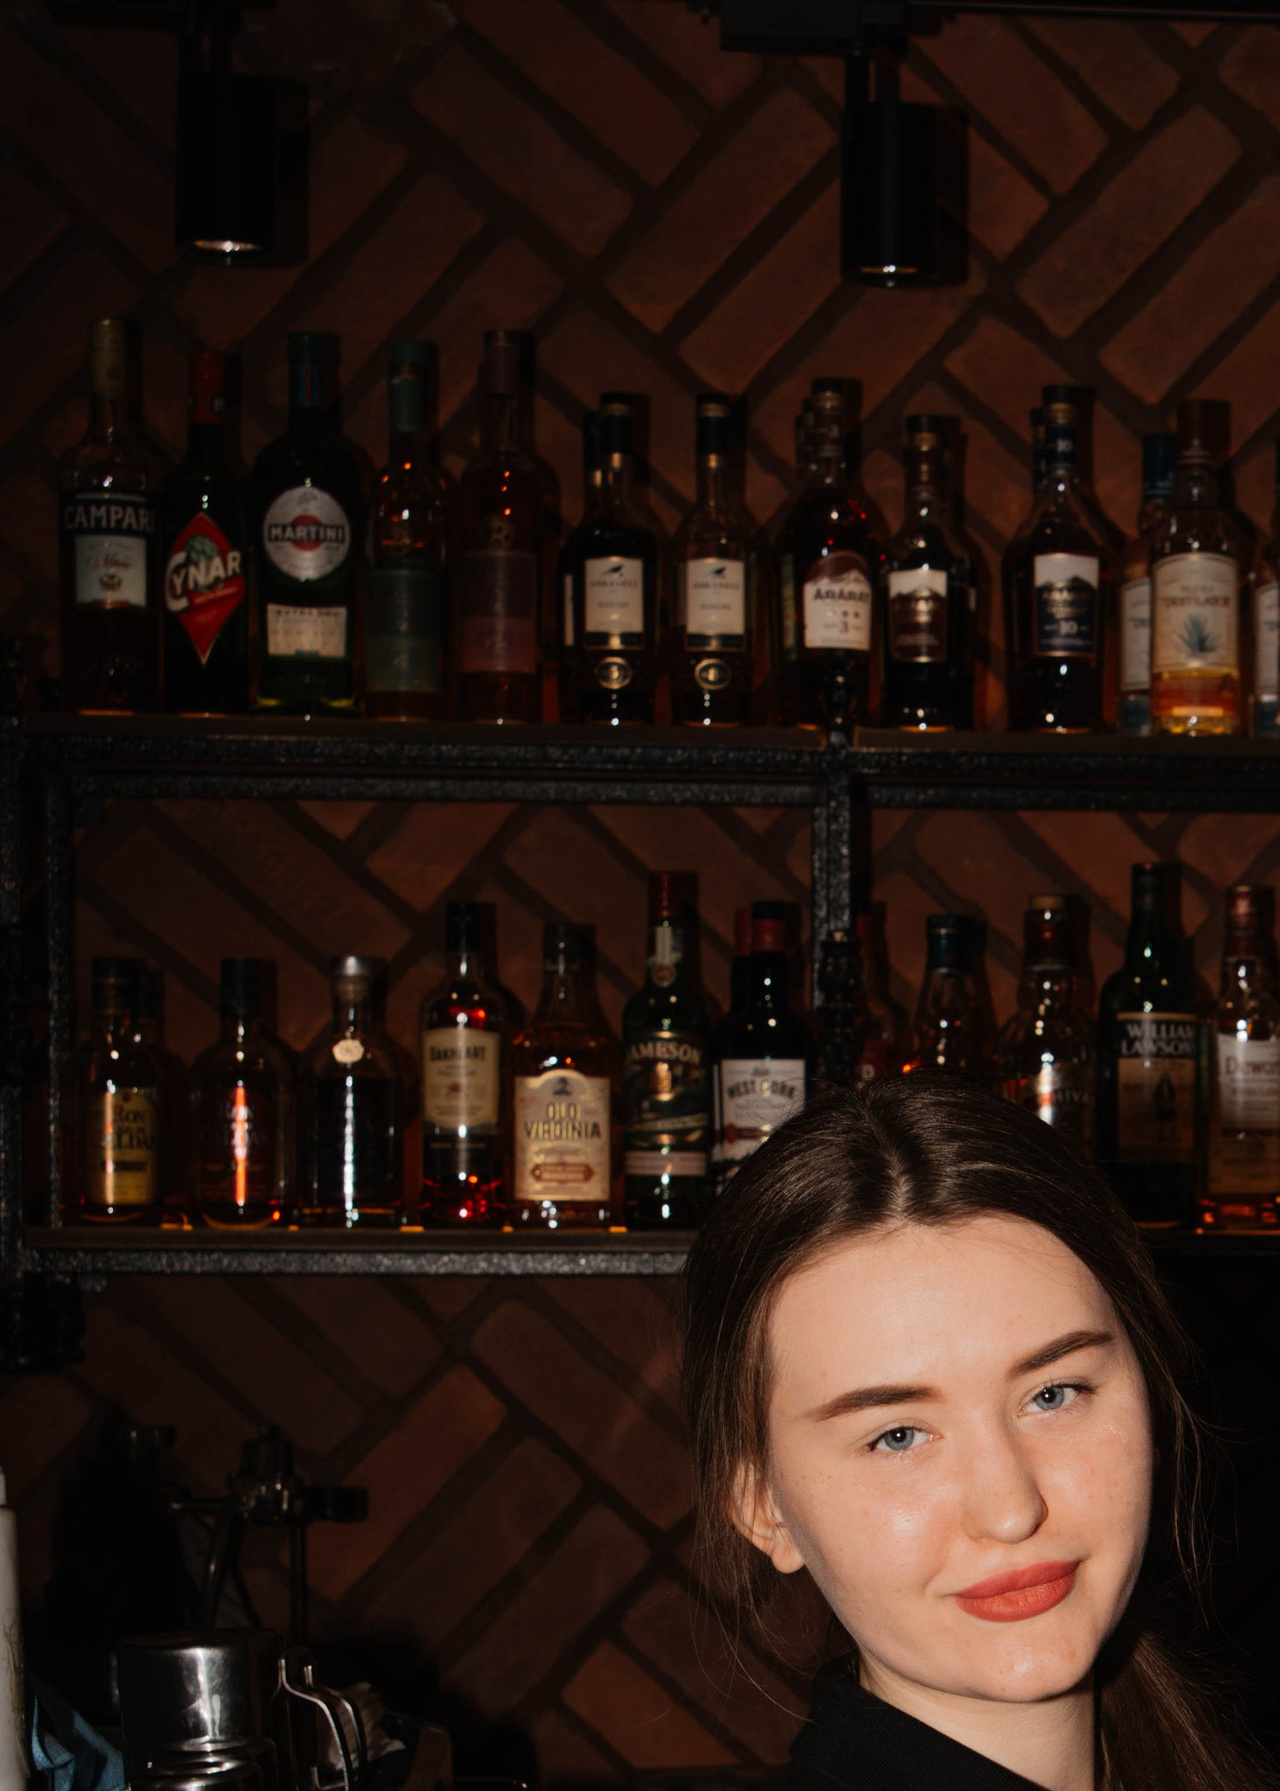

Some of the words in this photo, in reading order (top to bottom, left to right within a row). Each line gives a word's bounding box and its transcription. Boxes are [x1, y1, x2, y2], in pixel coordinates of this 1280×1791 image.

[63, 504, 155, 533] CAMPARI
[268, 523, 345, 542] MARTINI
[164, 549, 242, 612] CYNAR
[547, 1102, 582, 1120] OLD
[523, 1120, 602, 1140] VIRGINIA
